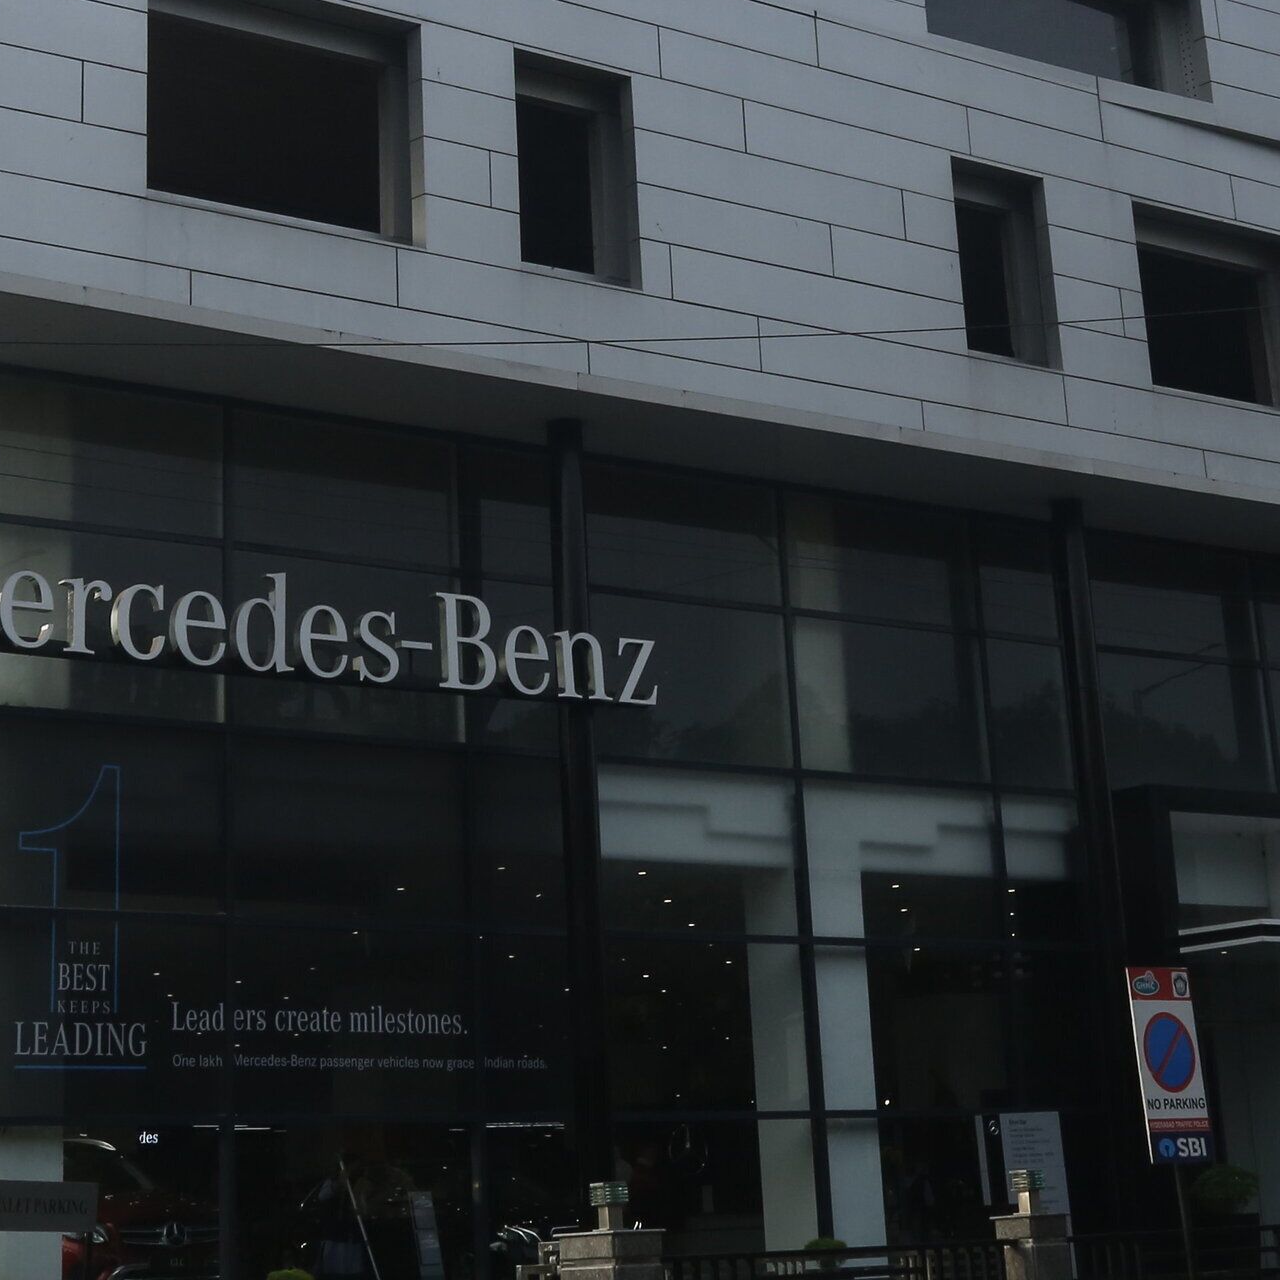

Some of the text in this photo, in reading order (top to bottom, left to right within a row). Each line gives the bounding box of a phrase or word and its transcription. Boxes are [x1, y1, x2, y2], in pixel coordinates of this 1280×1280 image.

[69, 941, 101, 955] THE
[58, 963, 110, 992] BEST
[57, 1000, 111, 1013] KEEPS
[275, 1009, 342, 1033] create
[350, 1006, 469, 1035] milestones.
[15, 1021, 148, 1057] LEADING
[172, 1054, 549, 1073] One lakh Mercedes-Benz passenger vehicles now grace Indian roads.
[1147, 1097, 1206, 1109] NO PARKING
[1176, 1136, 1207, 1158] SBI
